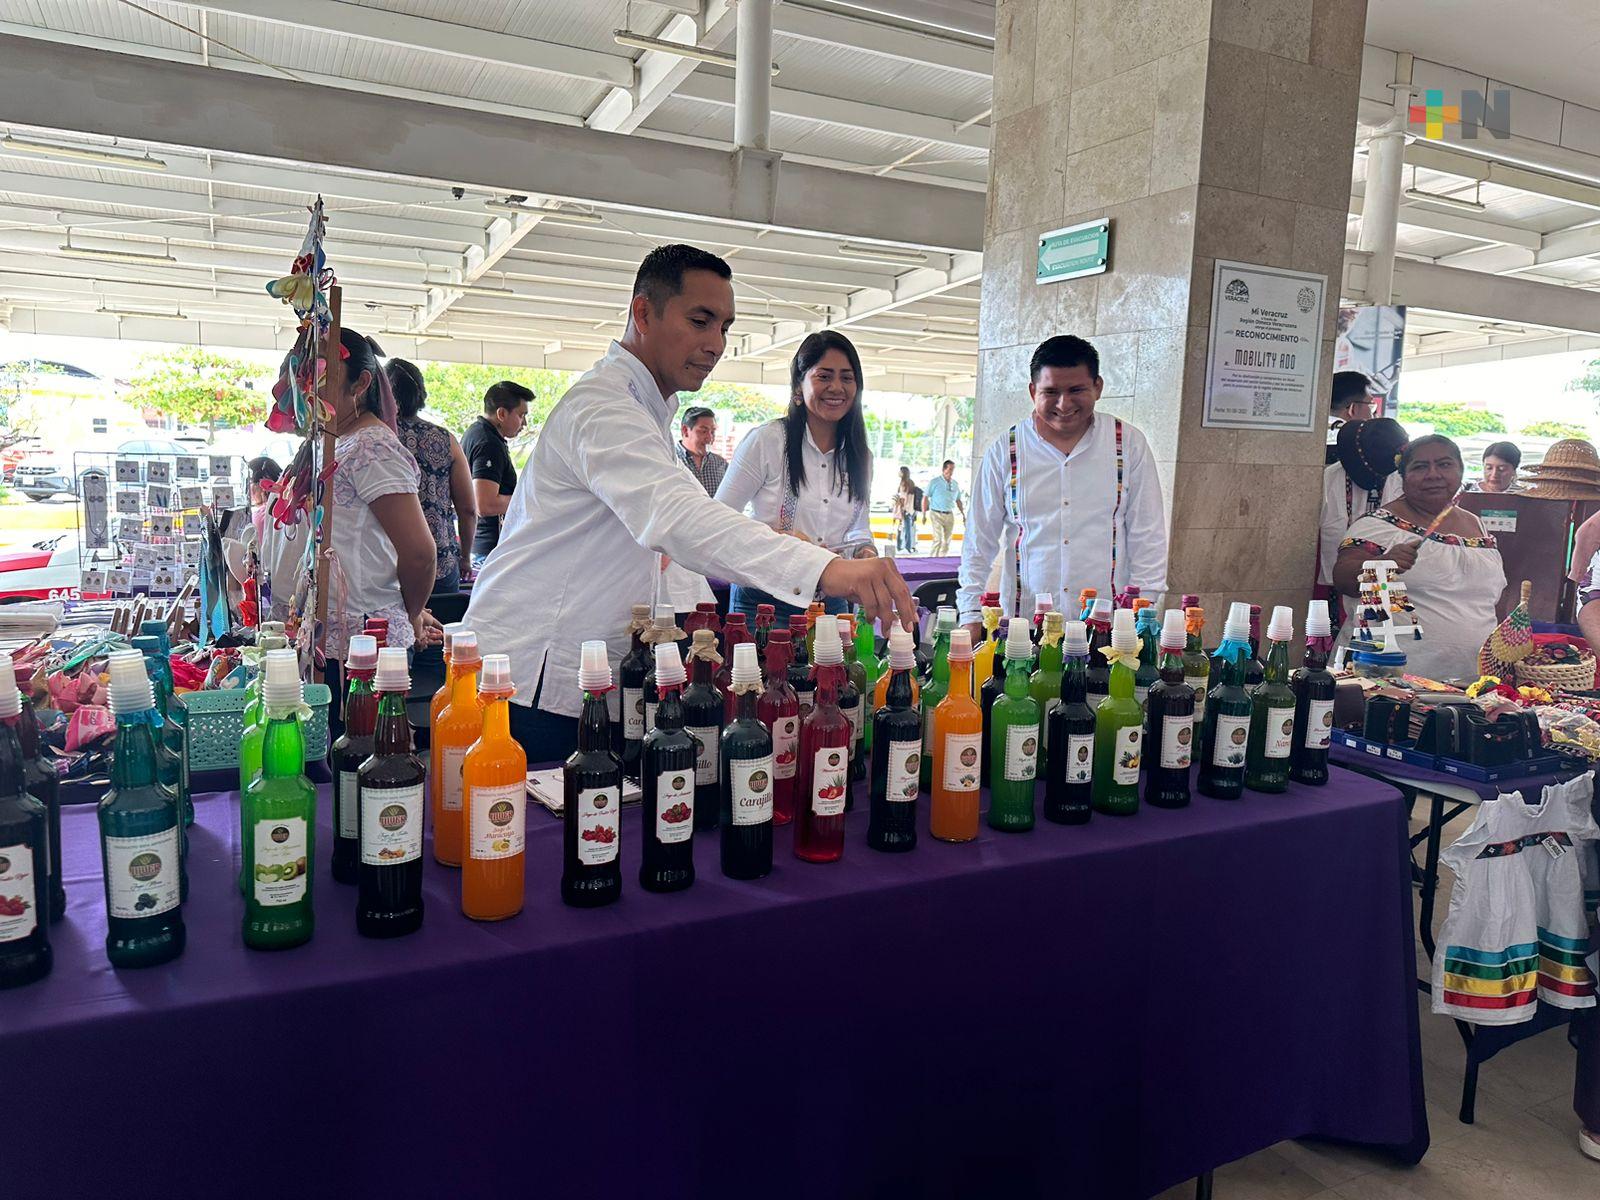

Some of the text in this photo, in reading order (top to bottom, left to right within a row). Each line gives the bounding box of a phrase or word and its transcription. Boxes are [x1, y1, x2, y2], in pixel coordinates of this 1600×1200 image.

[1260, 308, 1288, 319] Veracruz
[1235, 329, 1299, 343] RECONOCIMIENTO
[1234, 349, 1277, 368] MOBILITY
[48, 588, 81, 601] 645
